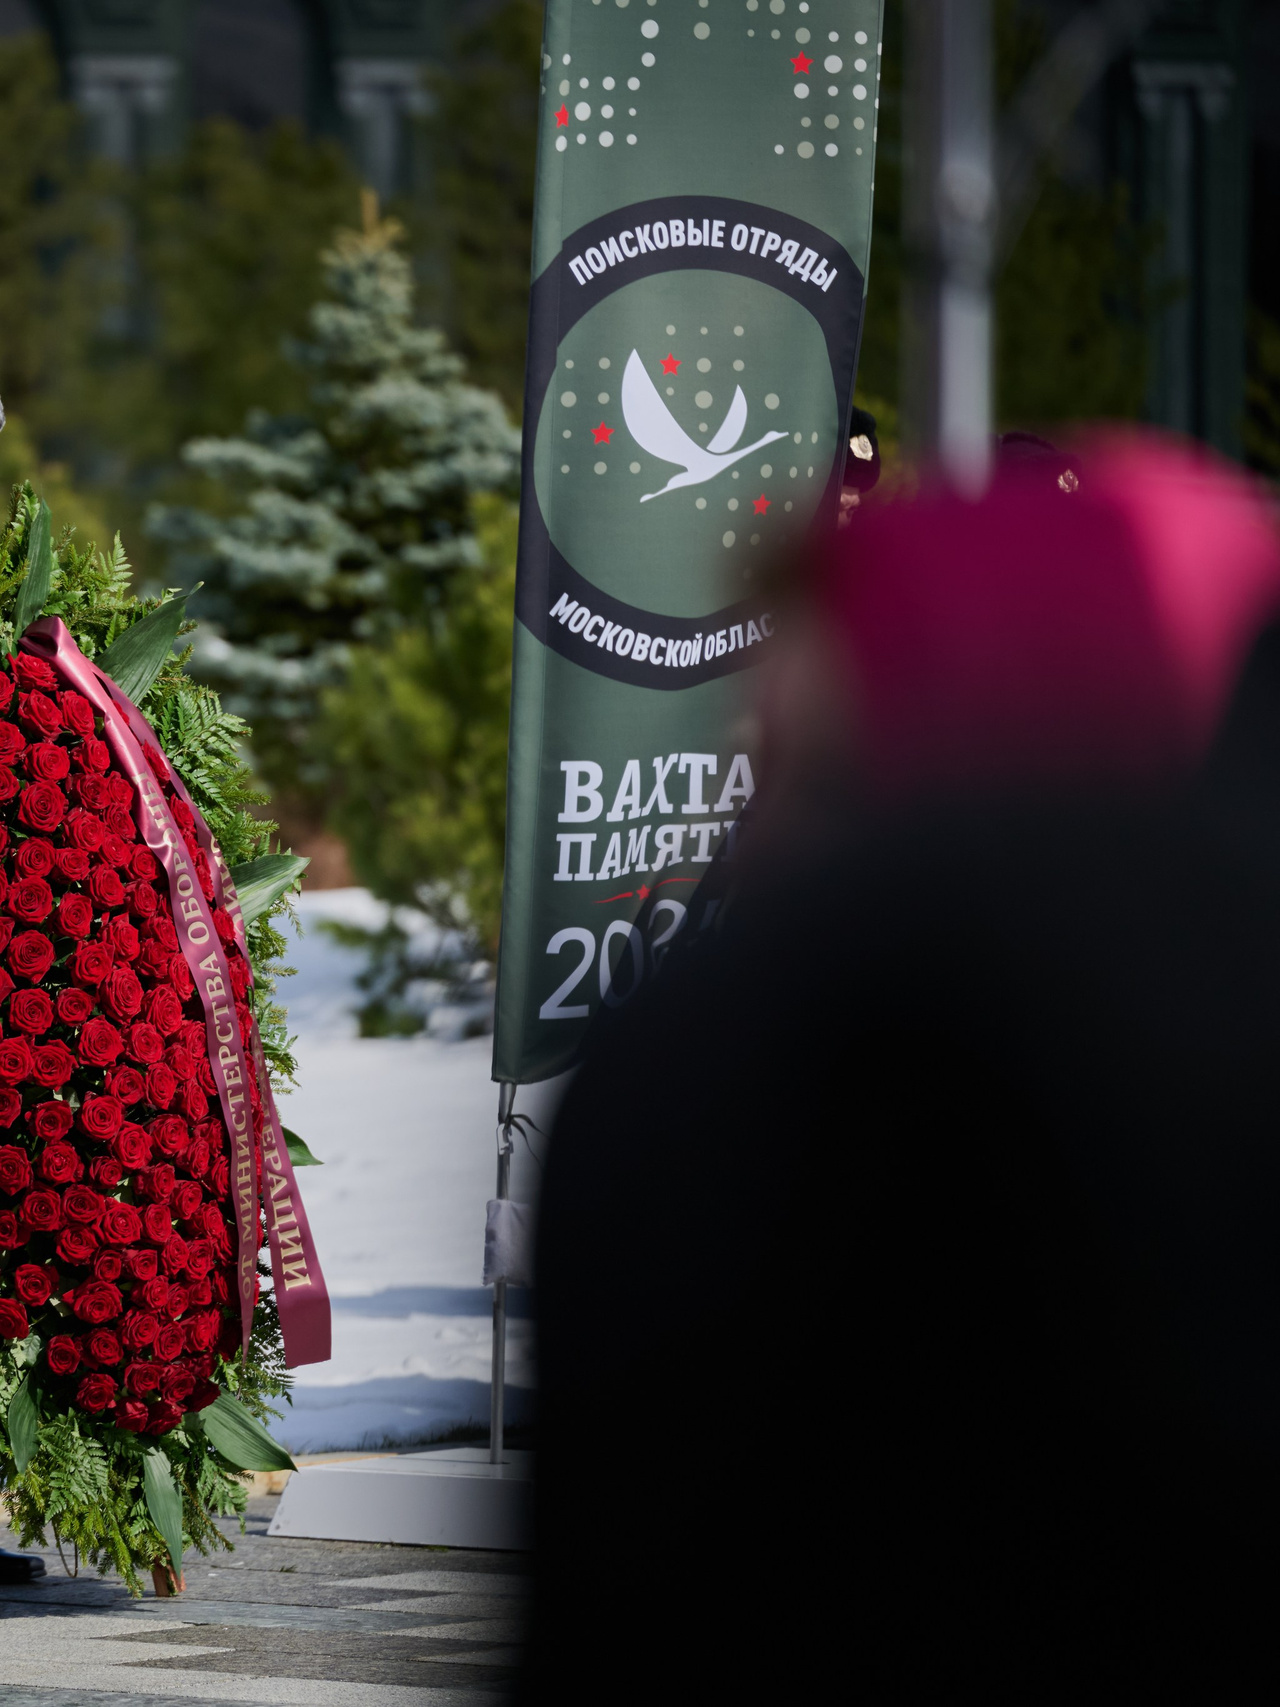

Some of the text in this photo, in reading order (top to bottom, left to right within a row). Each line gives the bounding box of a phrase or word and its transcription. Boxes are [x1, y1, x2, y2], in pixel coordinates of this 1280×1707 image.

[568, 218, 838, 292] ПОИСКОВЫЕ ОТРЯДЫ
[549, 592, 775, 668] МОСКОВСКОЙ ОБЛАС
[557, 752, 756, 823] ВАХТА
[132, 770, 211, 945] ОБОРОНЫ
[199, 950, 255, 1245] МИНИСТЕРСТВА
[241, 1254, 254, 1300] ОТ
